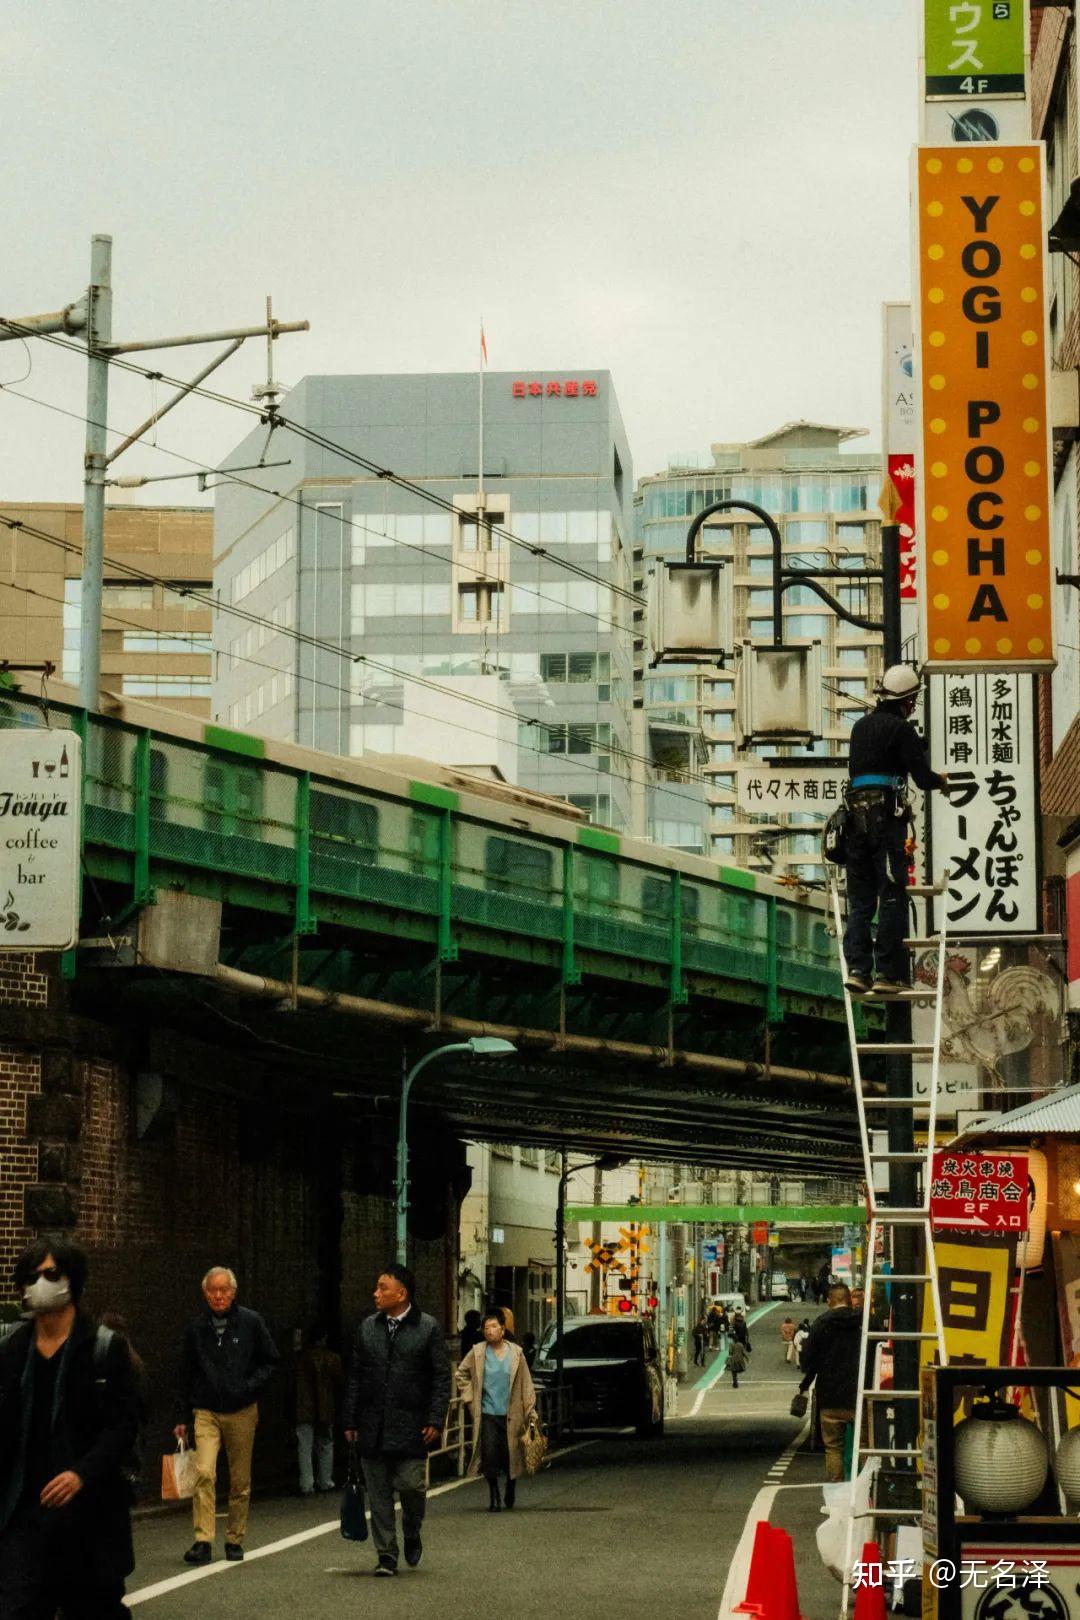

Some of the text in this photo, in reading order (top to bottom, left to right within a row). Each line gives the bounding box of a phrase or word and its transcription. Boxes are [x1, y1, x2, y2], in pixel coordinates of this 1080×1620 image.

[960, 77, 988, 93] 4F
[960, 195, 1001, 369] YOGI
[512, 381, 597, 398] 日本共産党
[965, 400, 1008, 622] POCHA
[949, 674, 973, 764] 鶏豚骨
[991, 674, 1013, 763] 多加水麺
[6, 828, 58, 849] coffee
[946, 771, 980, 921] ラーメン
[985, 769, 1023, 922] ちゃんぽん
[17, 863, 46, 884] bar
[942, 1158, 1014, 1178] 炭火串焼
[932, 1180, 1023, 1202] 焼鳥商会
[964, 1203, 989, 1213] 2F
[996, 1215, 1020, 1227] 入口
